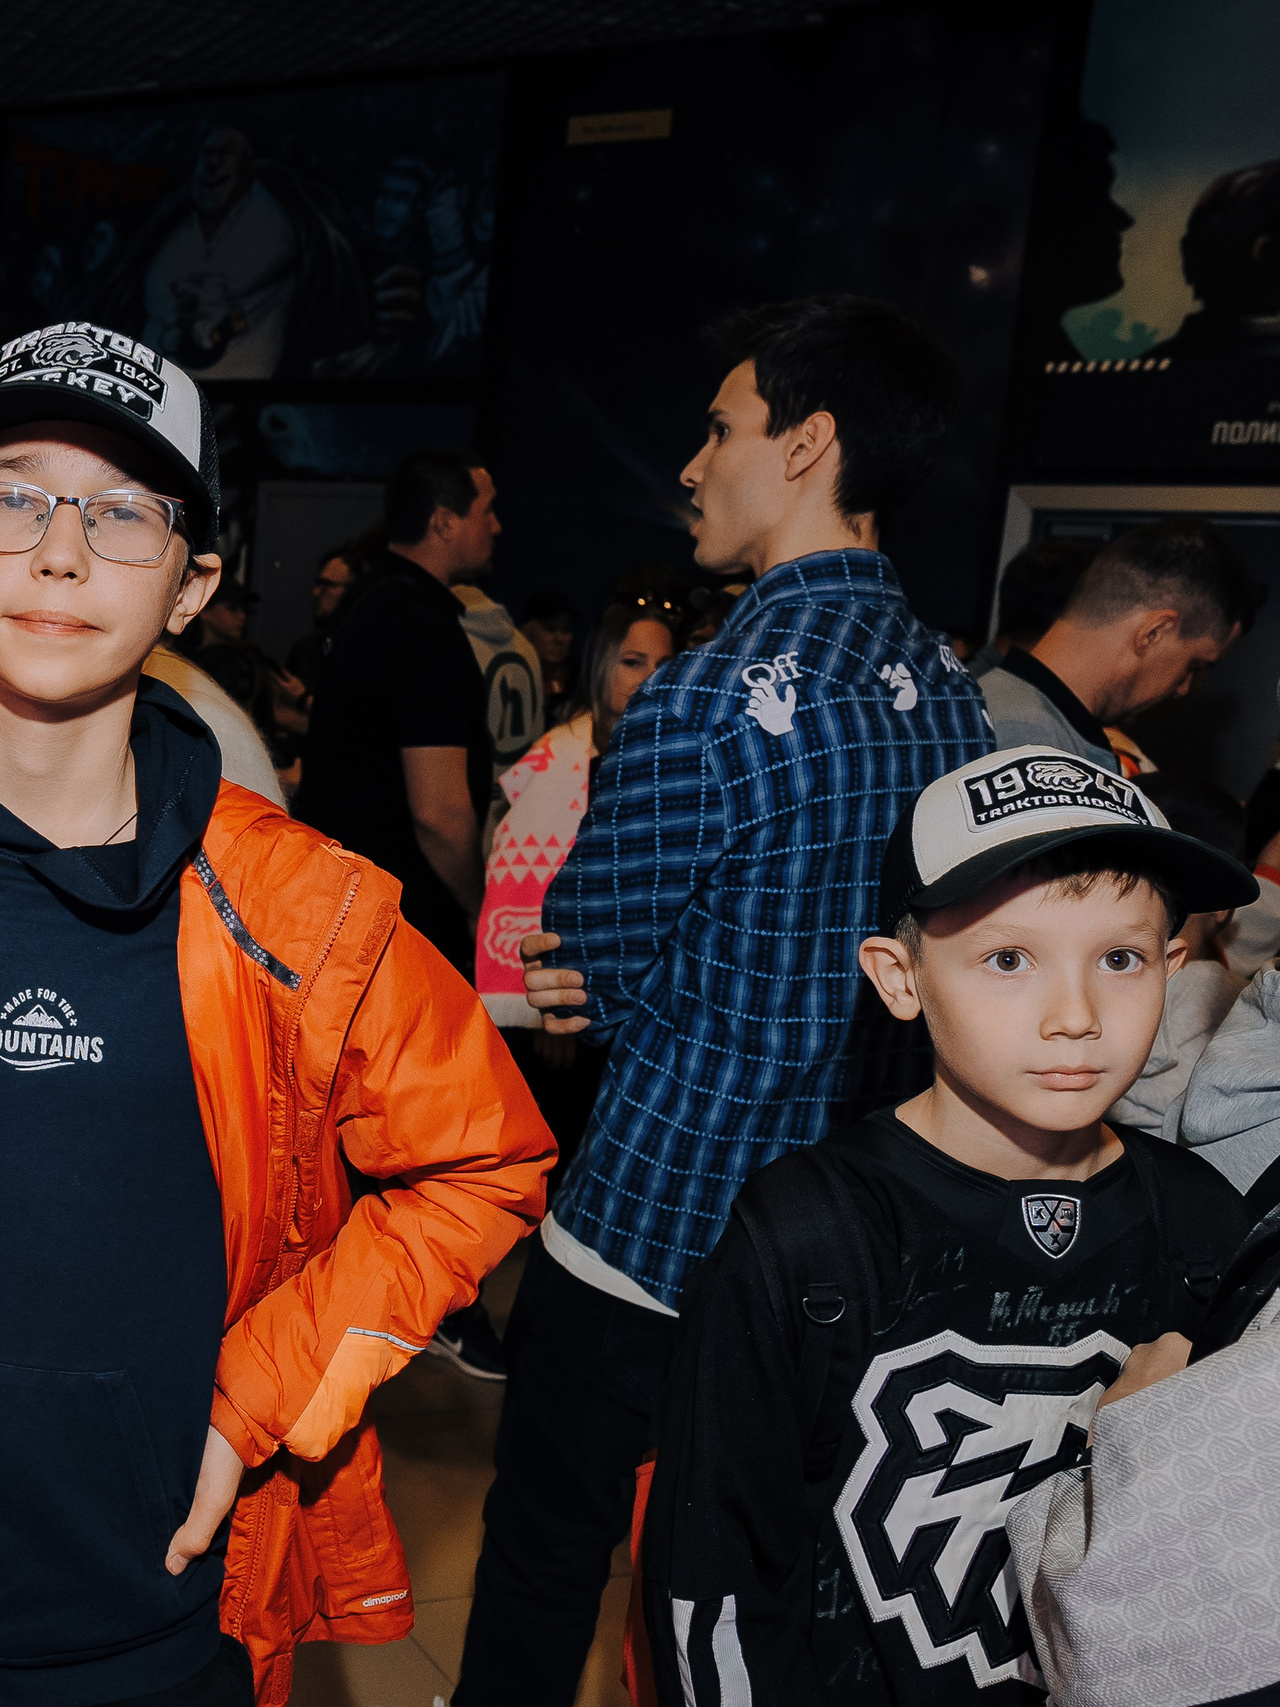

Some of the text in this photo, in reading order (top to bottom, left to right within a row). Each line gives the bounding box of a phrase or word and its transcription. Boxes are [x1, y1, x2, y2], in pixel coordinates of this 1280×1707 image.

[0, 321, 156, 370] TRAKTOR
[114, 359, 161, 392] 1947
[1211, 420, 1280, 446] ПОЛИ
[741, 651, 803, 688] Off
[977, 794, 1148, 825] TRAKTOR HOCKEY
[3, 987, 76, 1020] MADE FOR THE
[362, 1589, 408, 1608] climaproof
